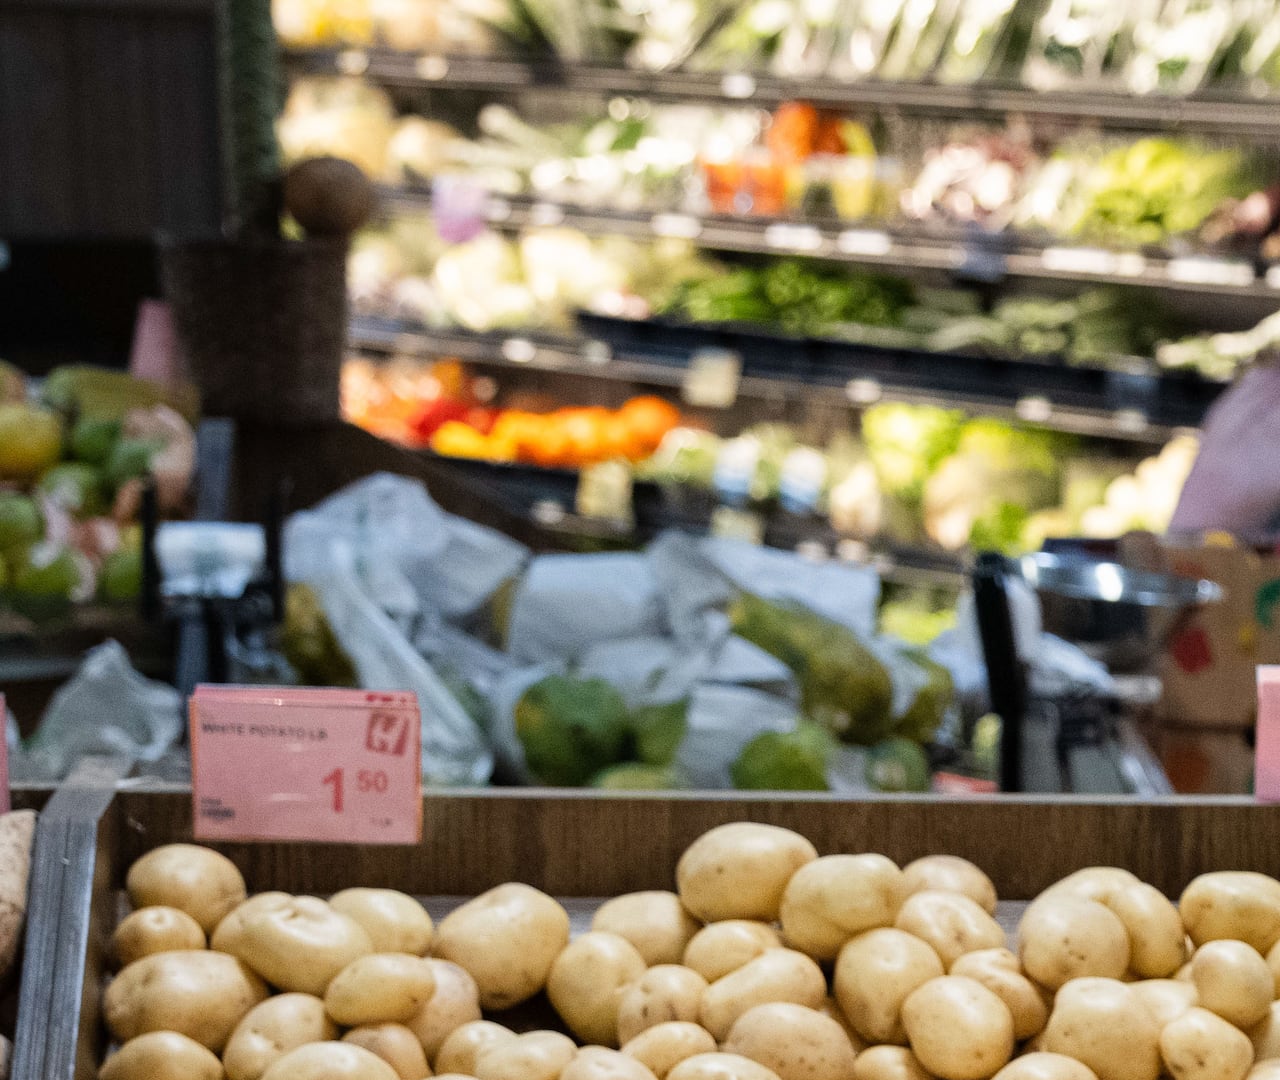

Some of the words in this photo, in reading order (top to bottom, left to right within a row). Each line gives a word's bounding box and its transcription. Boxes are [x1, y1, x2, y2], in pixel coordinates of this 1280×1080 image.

[202, 723, 244, 736] WHITE
[249, 724, 306, 739] POTATO
[322, 768, 344, 813] 1
[356, 770, 389, 792] 50
